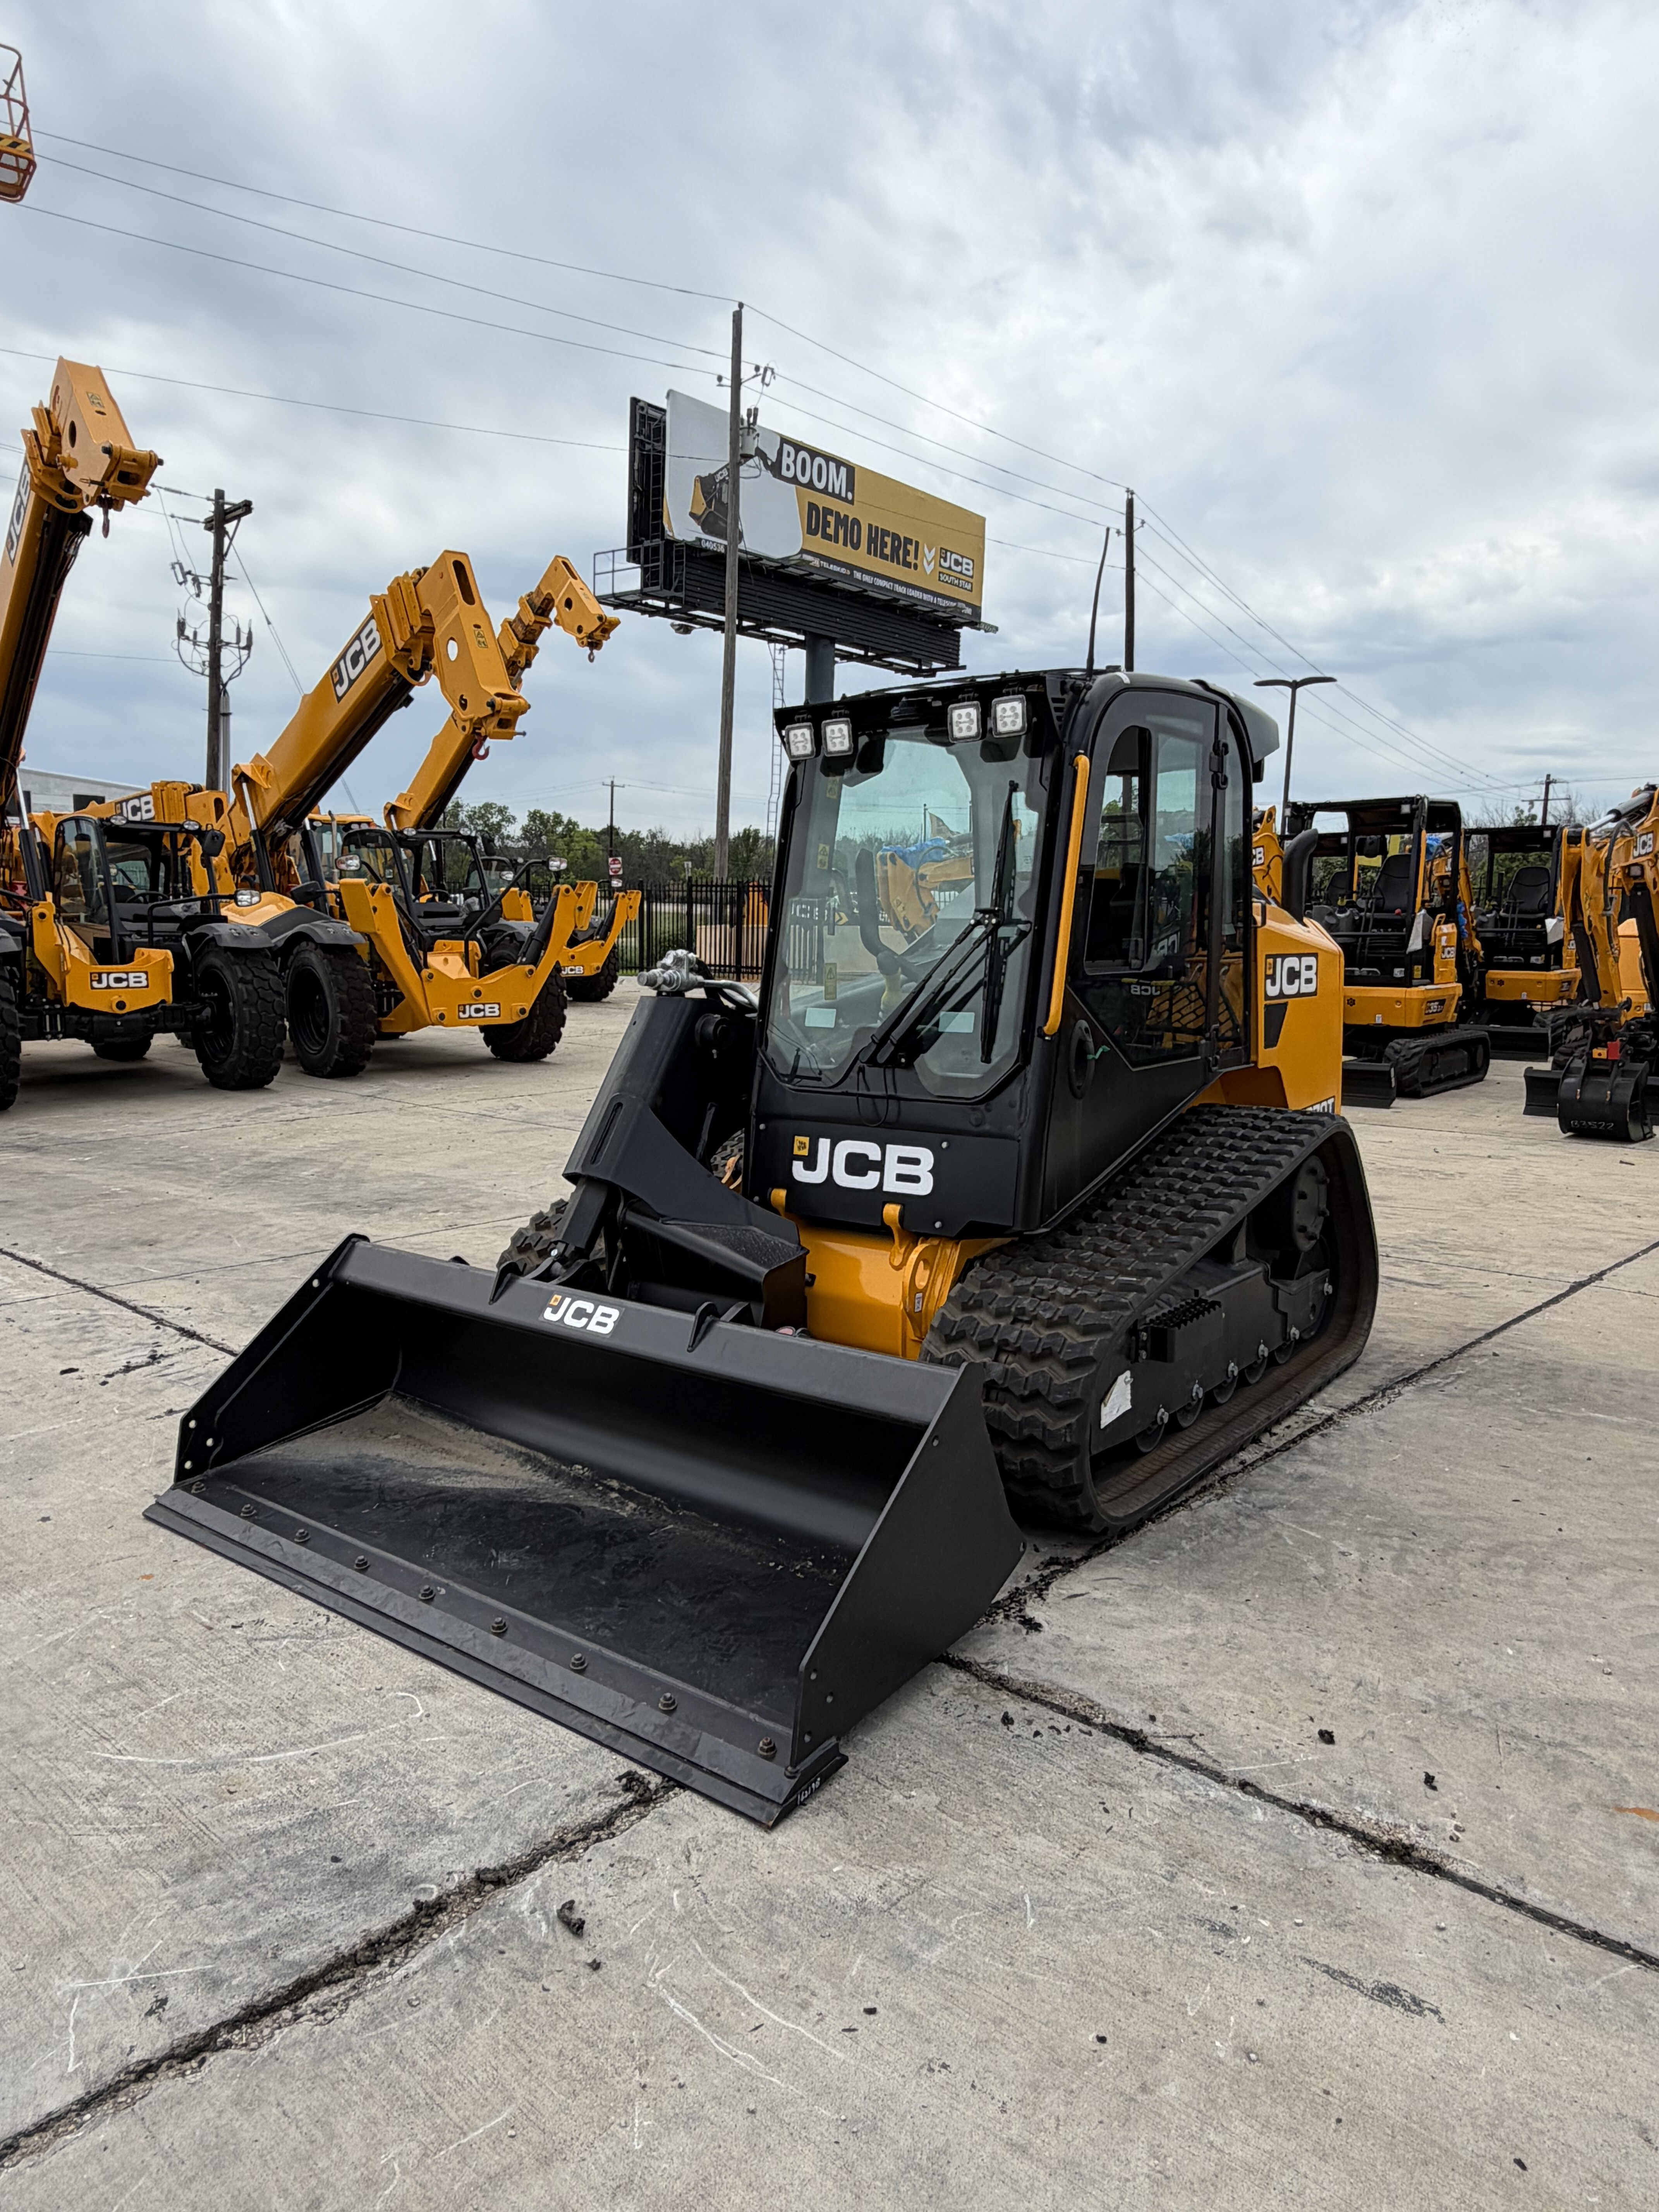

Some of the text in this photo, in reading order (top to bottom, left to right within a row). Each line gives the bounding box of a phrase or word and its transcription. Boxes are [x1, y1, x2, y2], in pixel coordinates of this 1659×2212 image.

[781, 443, 853, 501] BOOM.
[10, 464, 31, 560] JCB
[806, 501, 920, 571] DEMO HERE!
[853, 570, 862, 580] THE
[940, 551, 973, 577] JCB
[939, 573, 972, 591] SOUTH STAR
[335, 619, 381, 697] JCB
[1633, 833, 1653, 857] JCB
[92, 973, 147, 988] JCB
[562, 966, 583, 974] JCB
[1266, 957, 1317, 997] JCB
[459, 1004, 500, 1018] JCB
[792, 1138, 934, 1196] JCB
[544, 1297, 620, 1334] JCB
